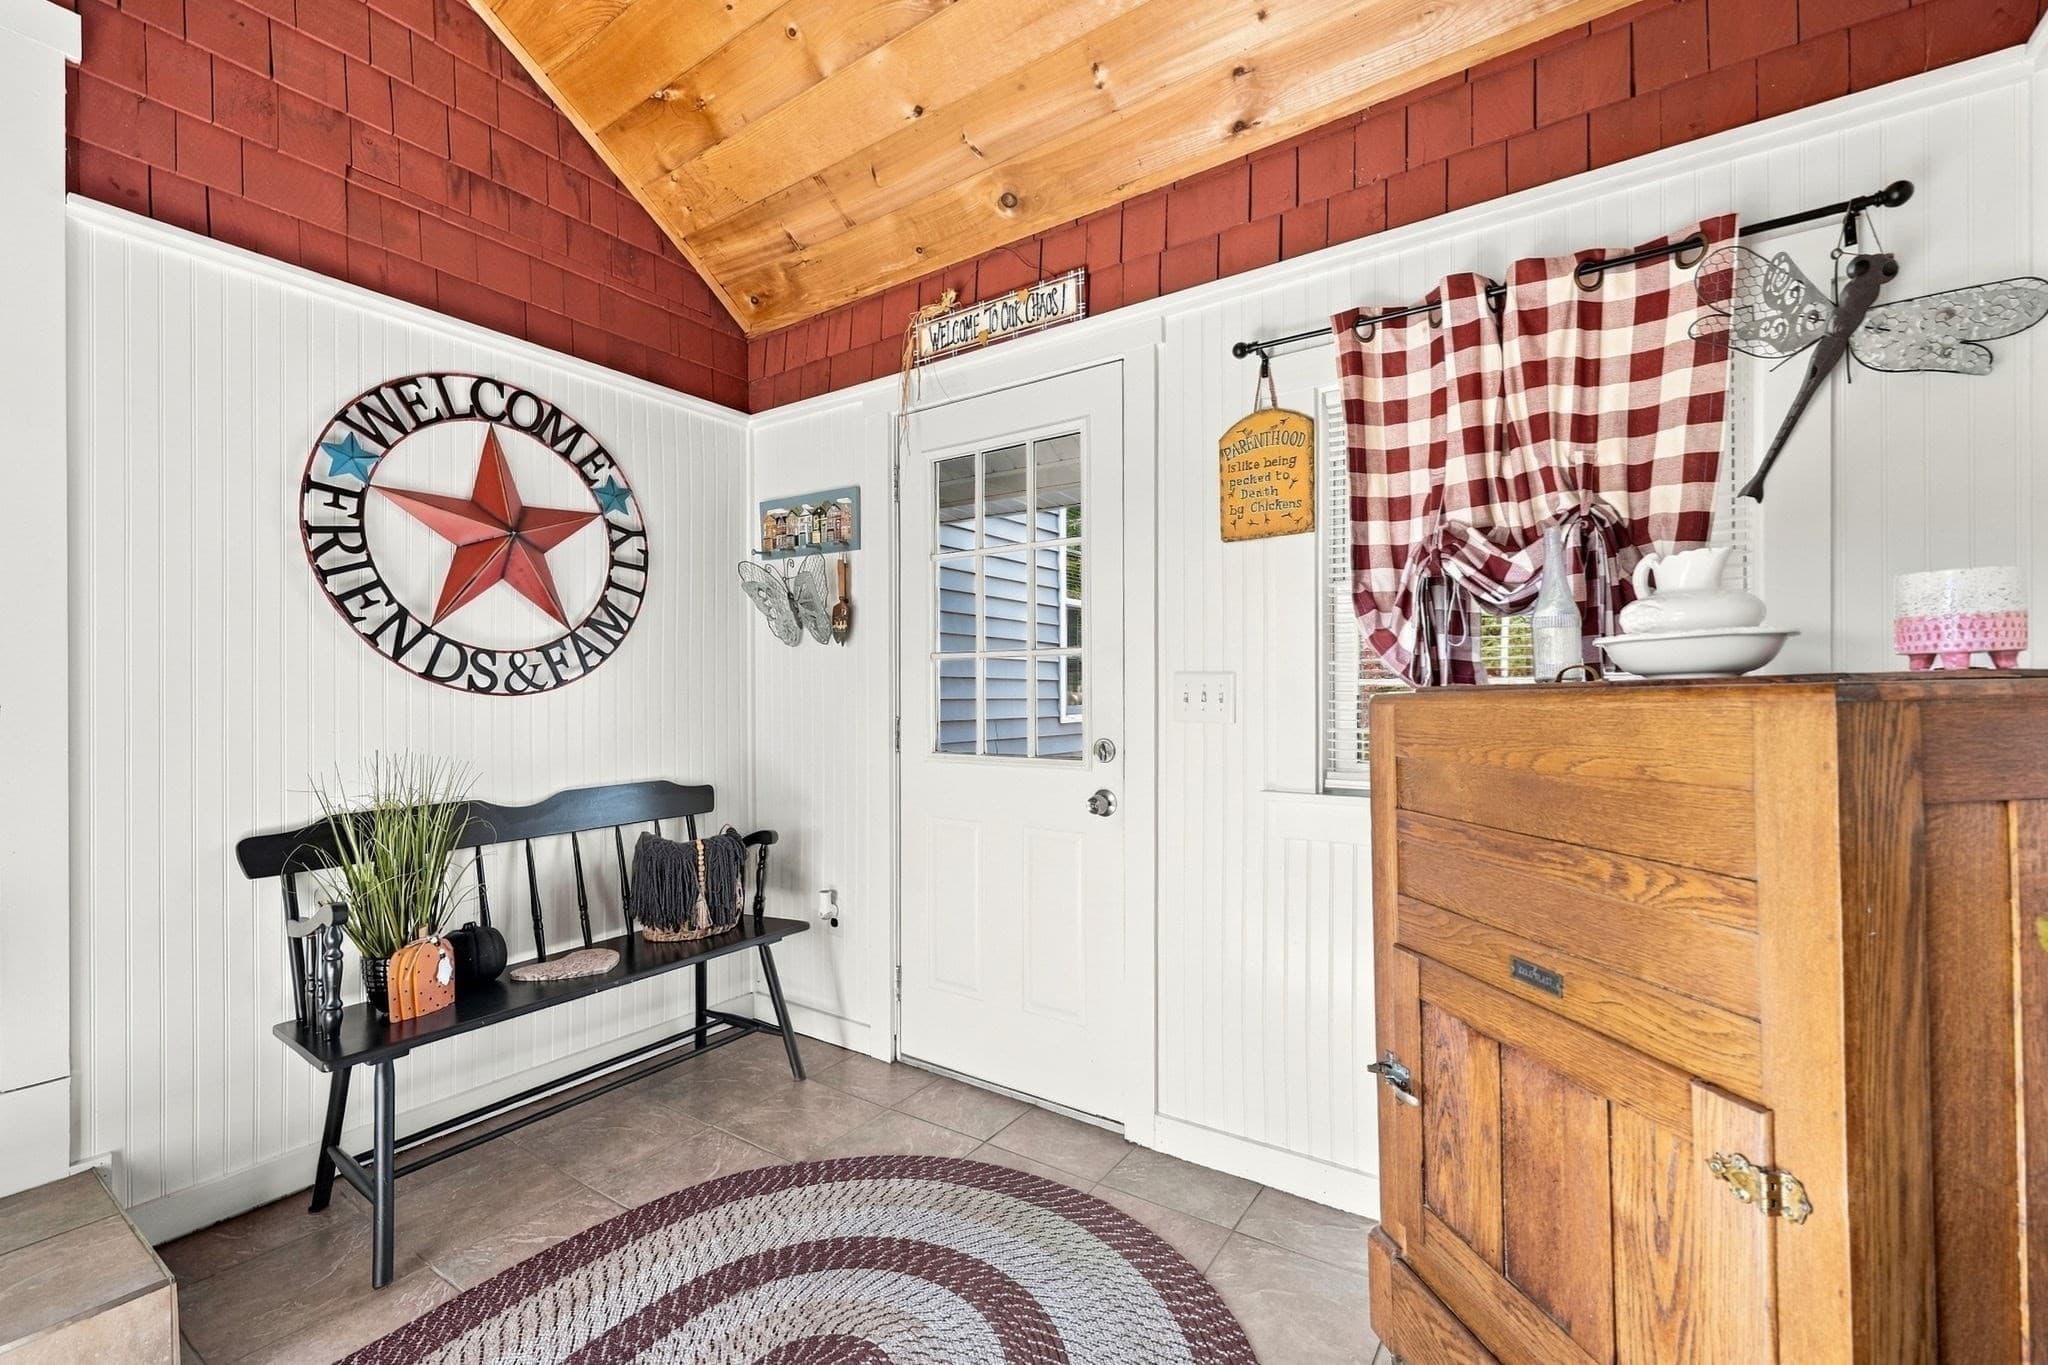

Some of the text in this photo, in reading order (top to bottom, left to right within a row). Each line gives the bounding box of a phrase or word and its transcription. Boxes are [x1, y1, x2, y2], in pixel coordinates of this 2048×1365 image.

[929, 313, 980, 352] WELCOME
[983, 304, 999, 335] TO
[336, 376, 615, 487] WELCOME
[1223, 430, 1306, 461] PARENTHOOD
[1238, 460, 1260, 472] like
[1264, 456, 1297, 469] being
[1229, 470, 1290, 490] pecked to
[1240, 486, 1278, 499] Death
[1229, 499, 1302, 519] by Chickens
[303, 473, 650, 693] FRIENDS & FAMILY
